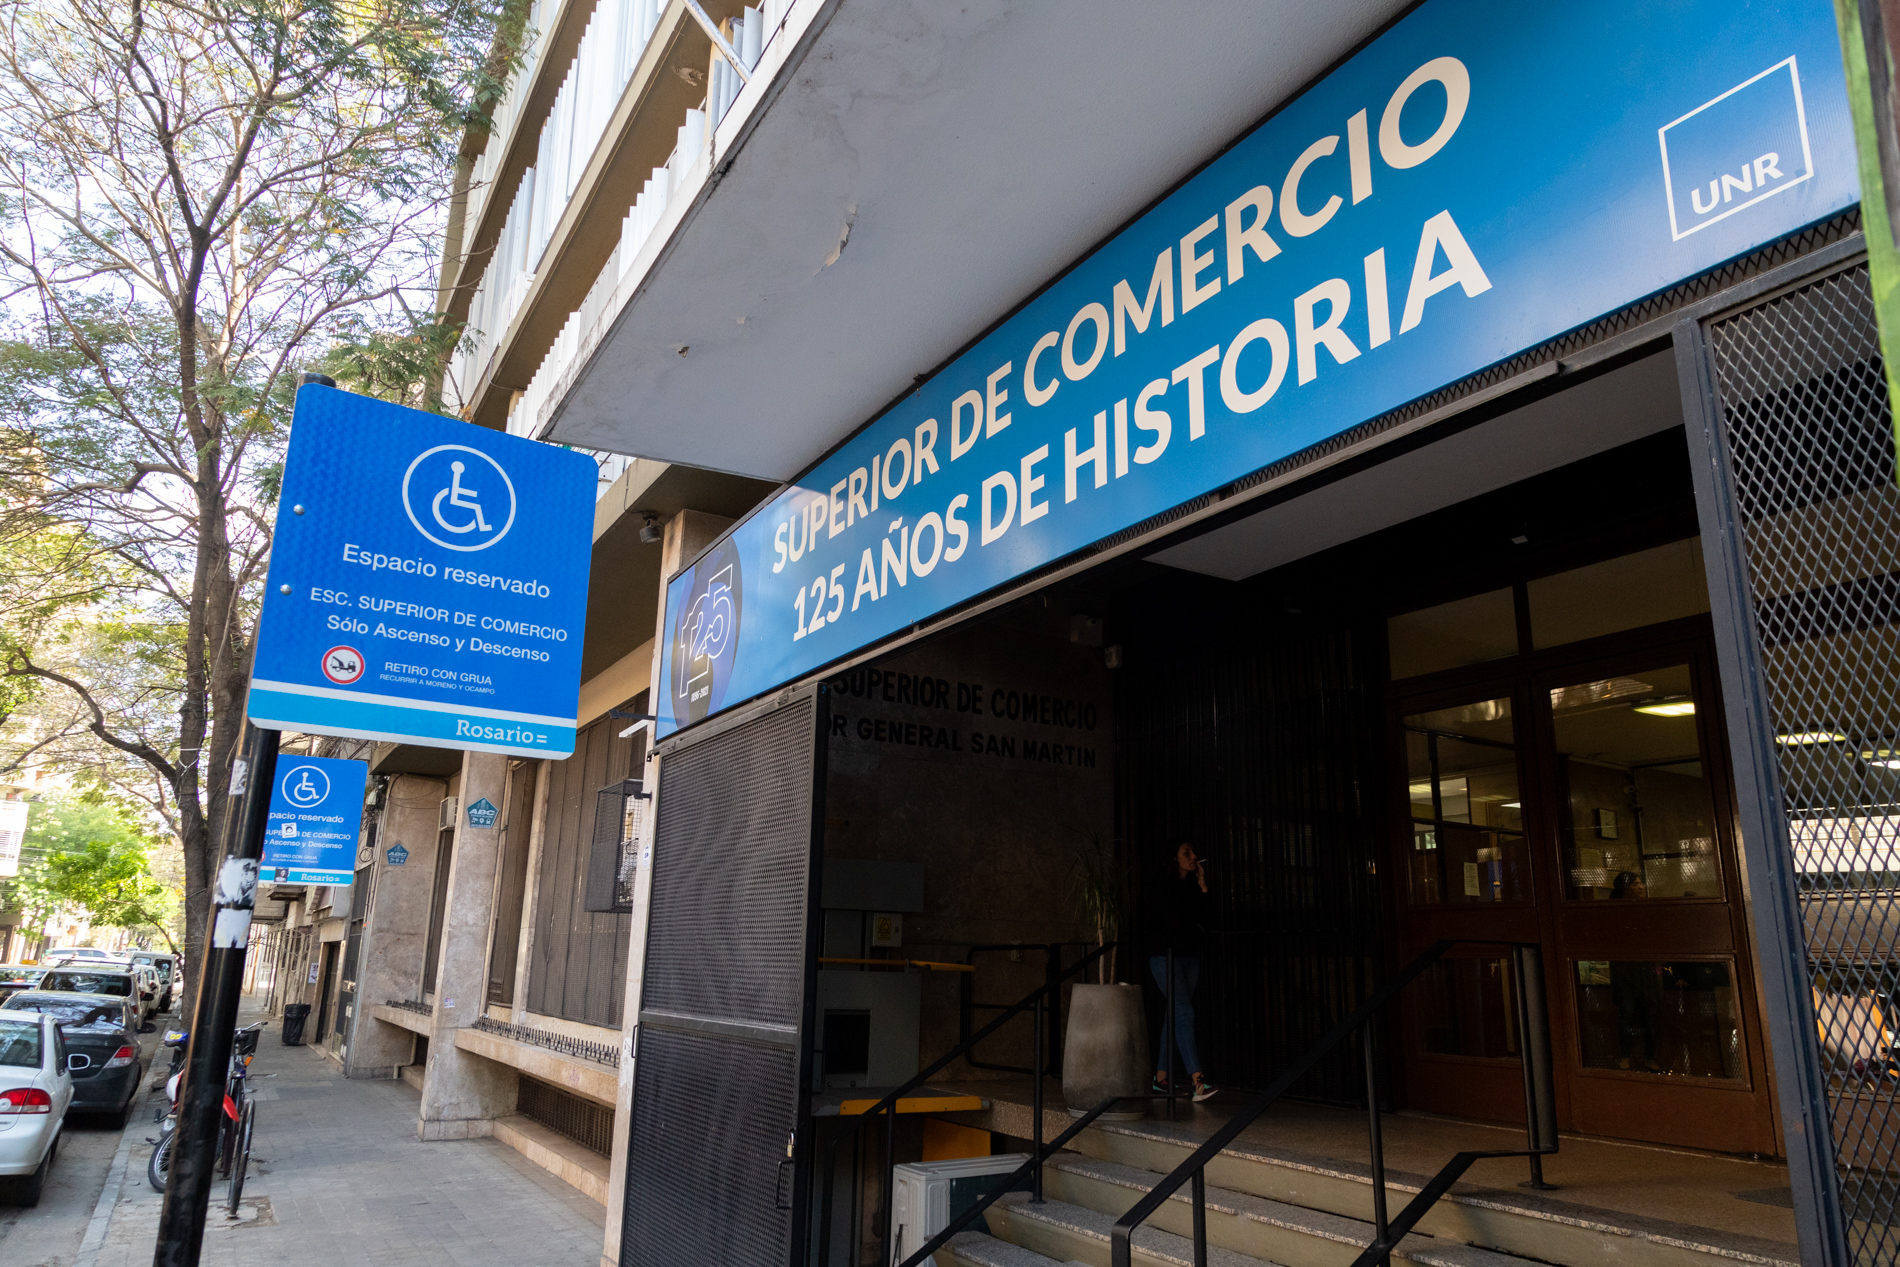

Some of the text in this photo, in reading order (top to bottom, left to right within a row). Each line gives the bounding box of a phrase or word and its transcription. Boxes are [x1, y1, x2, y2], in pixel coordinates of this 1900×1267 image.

[1691, 152, 1785, 215] UNR
[772, 57, 1471, 573] SUPERIOR DE COMERCIO
[794, 210, 1493, 642] 125 AÑOS DE HISTORIA
[343, 543, 550, 598] Espacio reservado
[310, 587, 567, 641] ESC. SUPERIOR DE COMERCIO
[327, 615, 550, 662] Sólo Ascenso y Descenso
[679, 563, 733, 698] 125
[379, 673, 418, 684] RECURRIR
[425, 680, 457, 690] MORENO
[464, 685, 495, 695] OCAMPO
[384, 661, 492, 685] RETIRO CON GRUA
[833, 669, 1098, 731] SUPERIOR DE COMERCIO
[856, 717, 963, 752] GENERAL
[971, 732, 1015, 758] SAN
[1023, 739, 1096, 768] MARTIN
[268, 812, 345, 823] pacio reservado
[313, 832, 351, 841] COMERCIO
[469, 808, 496, 816] ABC
[269, 839, 301, 847] Ascenso
[308, 841, 343, 849] Descenso
